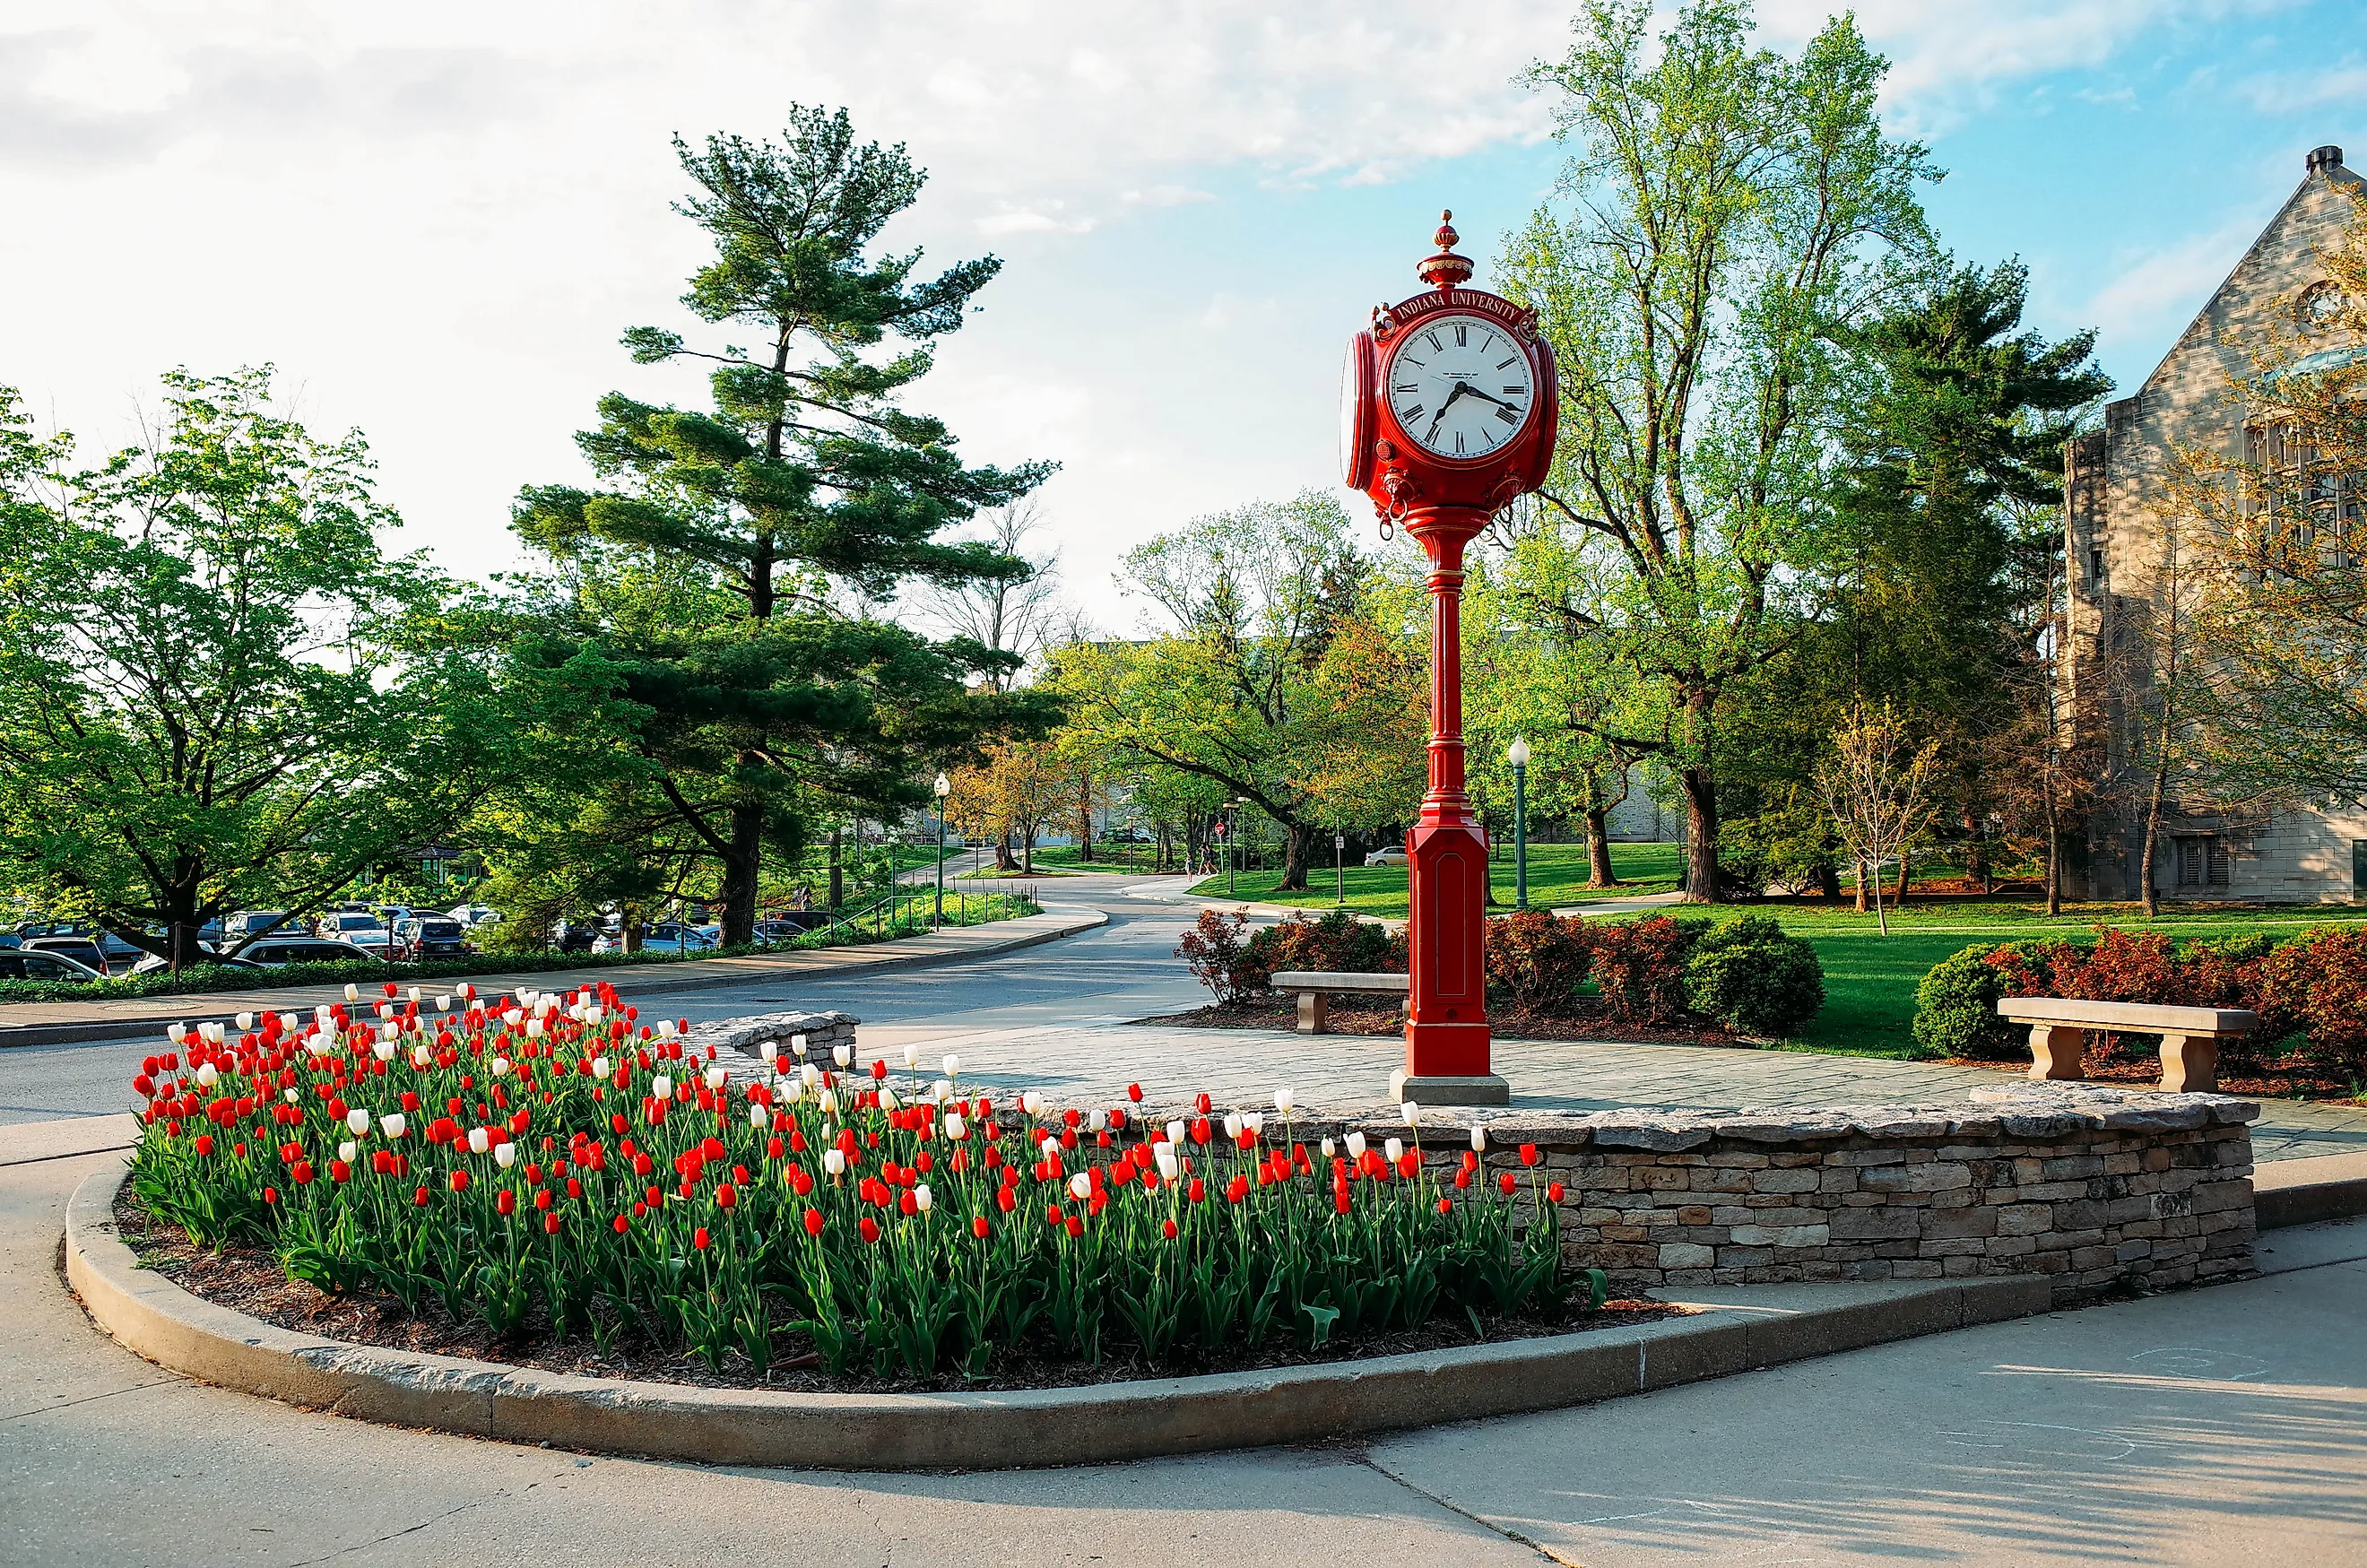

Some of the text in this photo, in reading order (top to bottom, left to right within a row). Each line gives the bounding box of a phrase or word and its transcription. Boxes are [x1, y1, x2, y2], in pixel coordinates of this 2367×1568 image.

[1398, 291, 1518, 320] INDIANA UNIVERSITY
[1426, 332, 1444, 354] XI
[1454, 326, 1467, 347] XII
[1404, 354, 1426, 370] X
[1496, 357, 1516, 370] II
[1397, 384, 1418, 394] IX
[1504, 386, 1524, 394] III
[1456, 431, 1465, 453] VI
